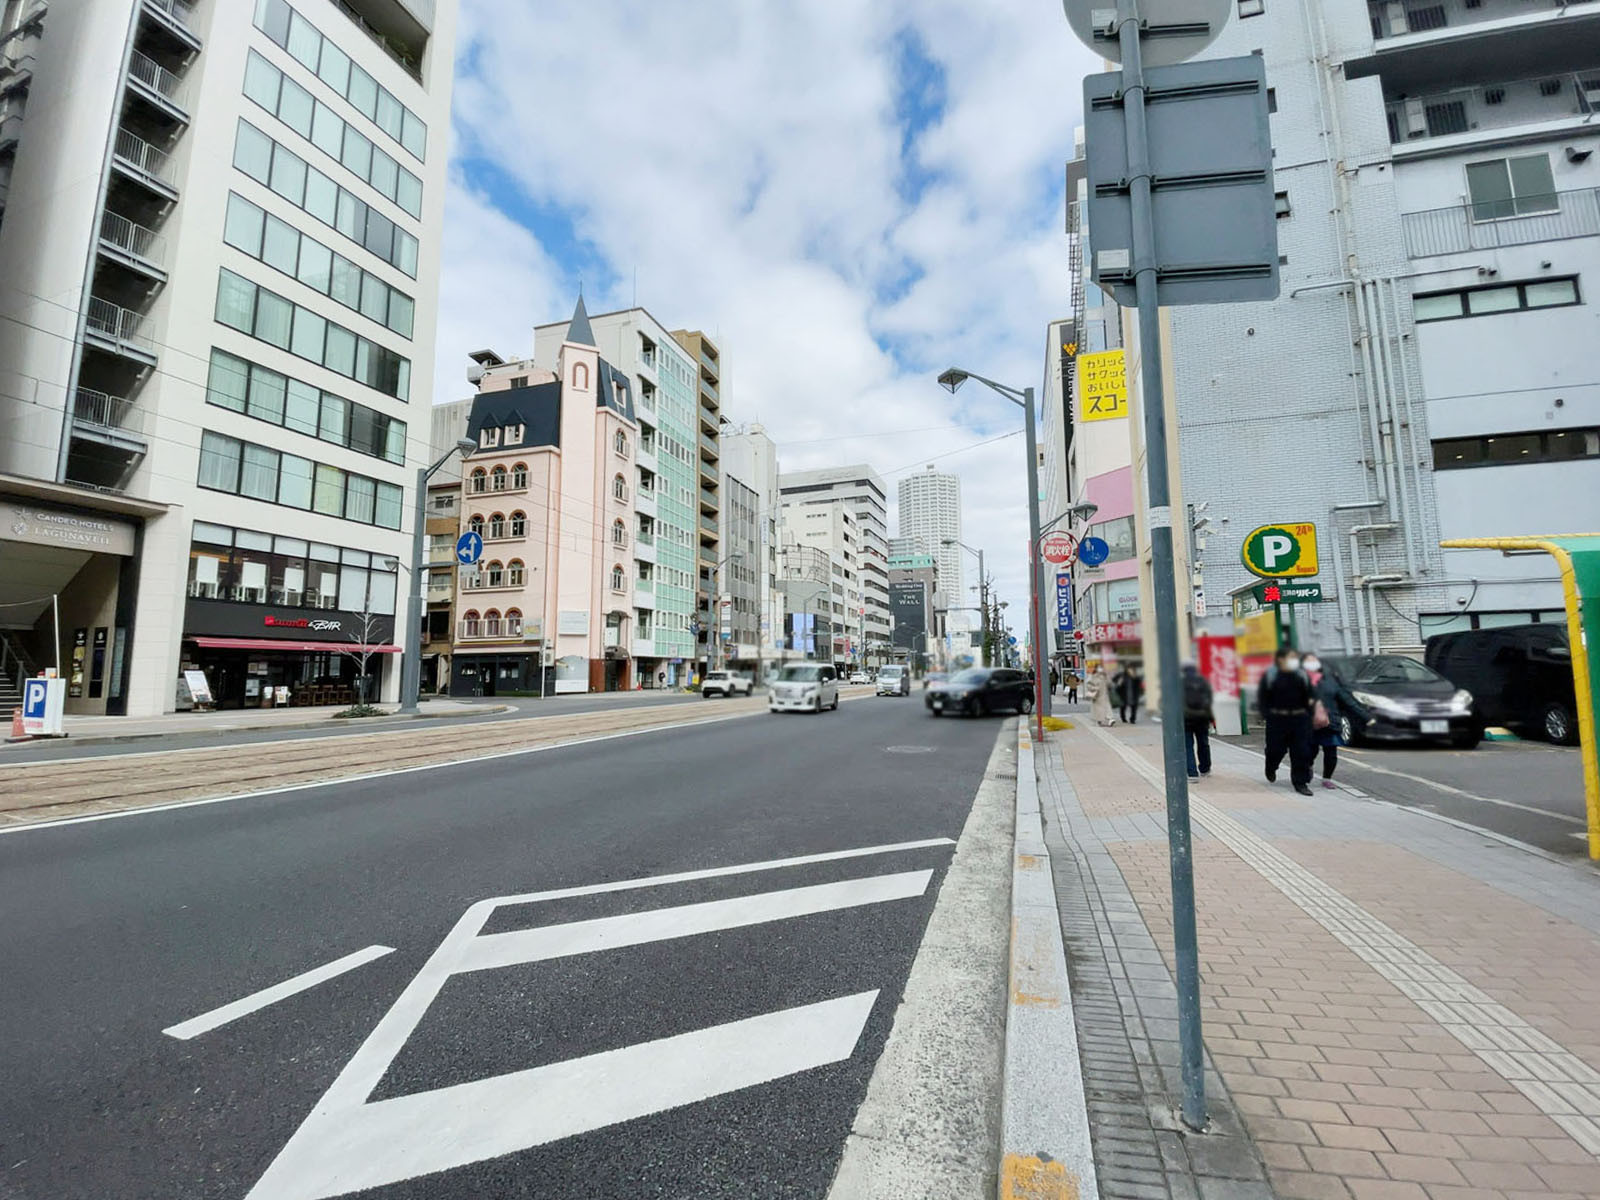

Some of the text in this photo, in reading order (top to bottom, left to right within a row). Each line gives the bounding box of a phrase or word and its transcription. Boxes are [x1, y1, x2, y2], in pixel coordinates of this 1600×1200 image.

[1086, 355, 1125, 370] カリッと
[1087, 367, 1126, 381] サクッと
[37, 513, 78, 526] CANDEO
[79, 521, 114, 532] HOTELS
[1046, 544, 1070, 556] 消火栓
[1262, 536, 1293, 568] P
[1263, 586, 1281, 602] 満
[27, 683, 46, 714] P
